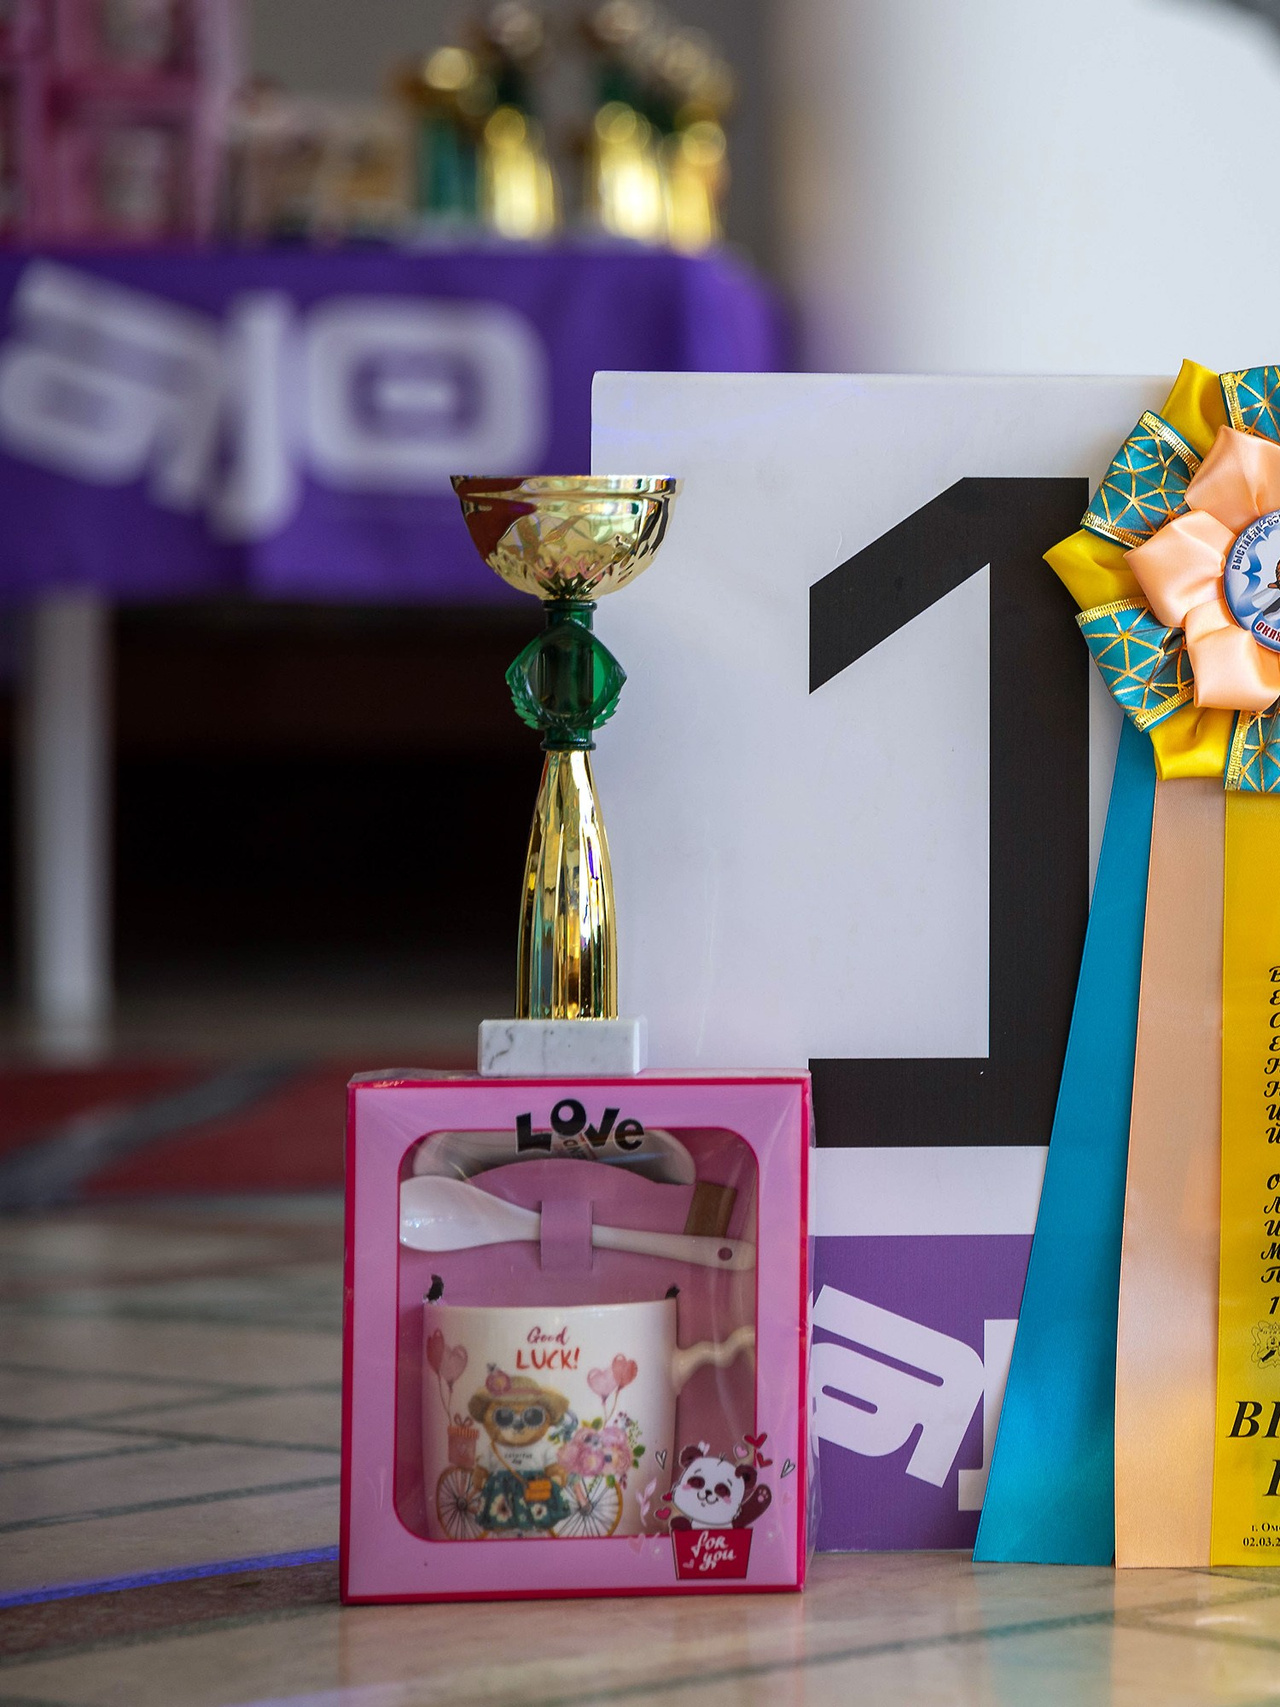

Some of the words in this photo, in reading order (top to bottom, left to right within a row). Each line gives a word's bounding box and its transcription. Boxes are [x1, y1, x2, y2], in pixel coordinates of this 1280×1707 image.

[808, 477, 1090, 1148] 1
[1269, 1296, 1280, 1315] 1
[527, 1326, 570, 1346] Good
[516, 1347, 580, 1370] LUCK!
[699, 1549, 737, 1571] you
